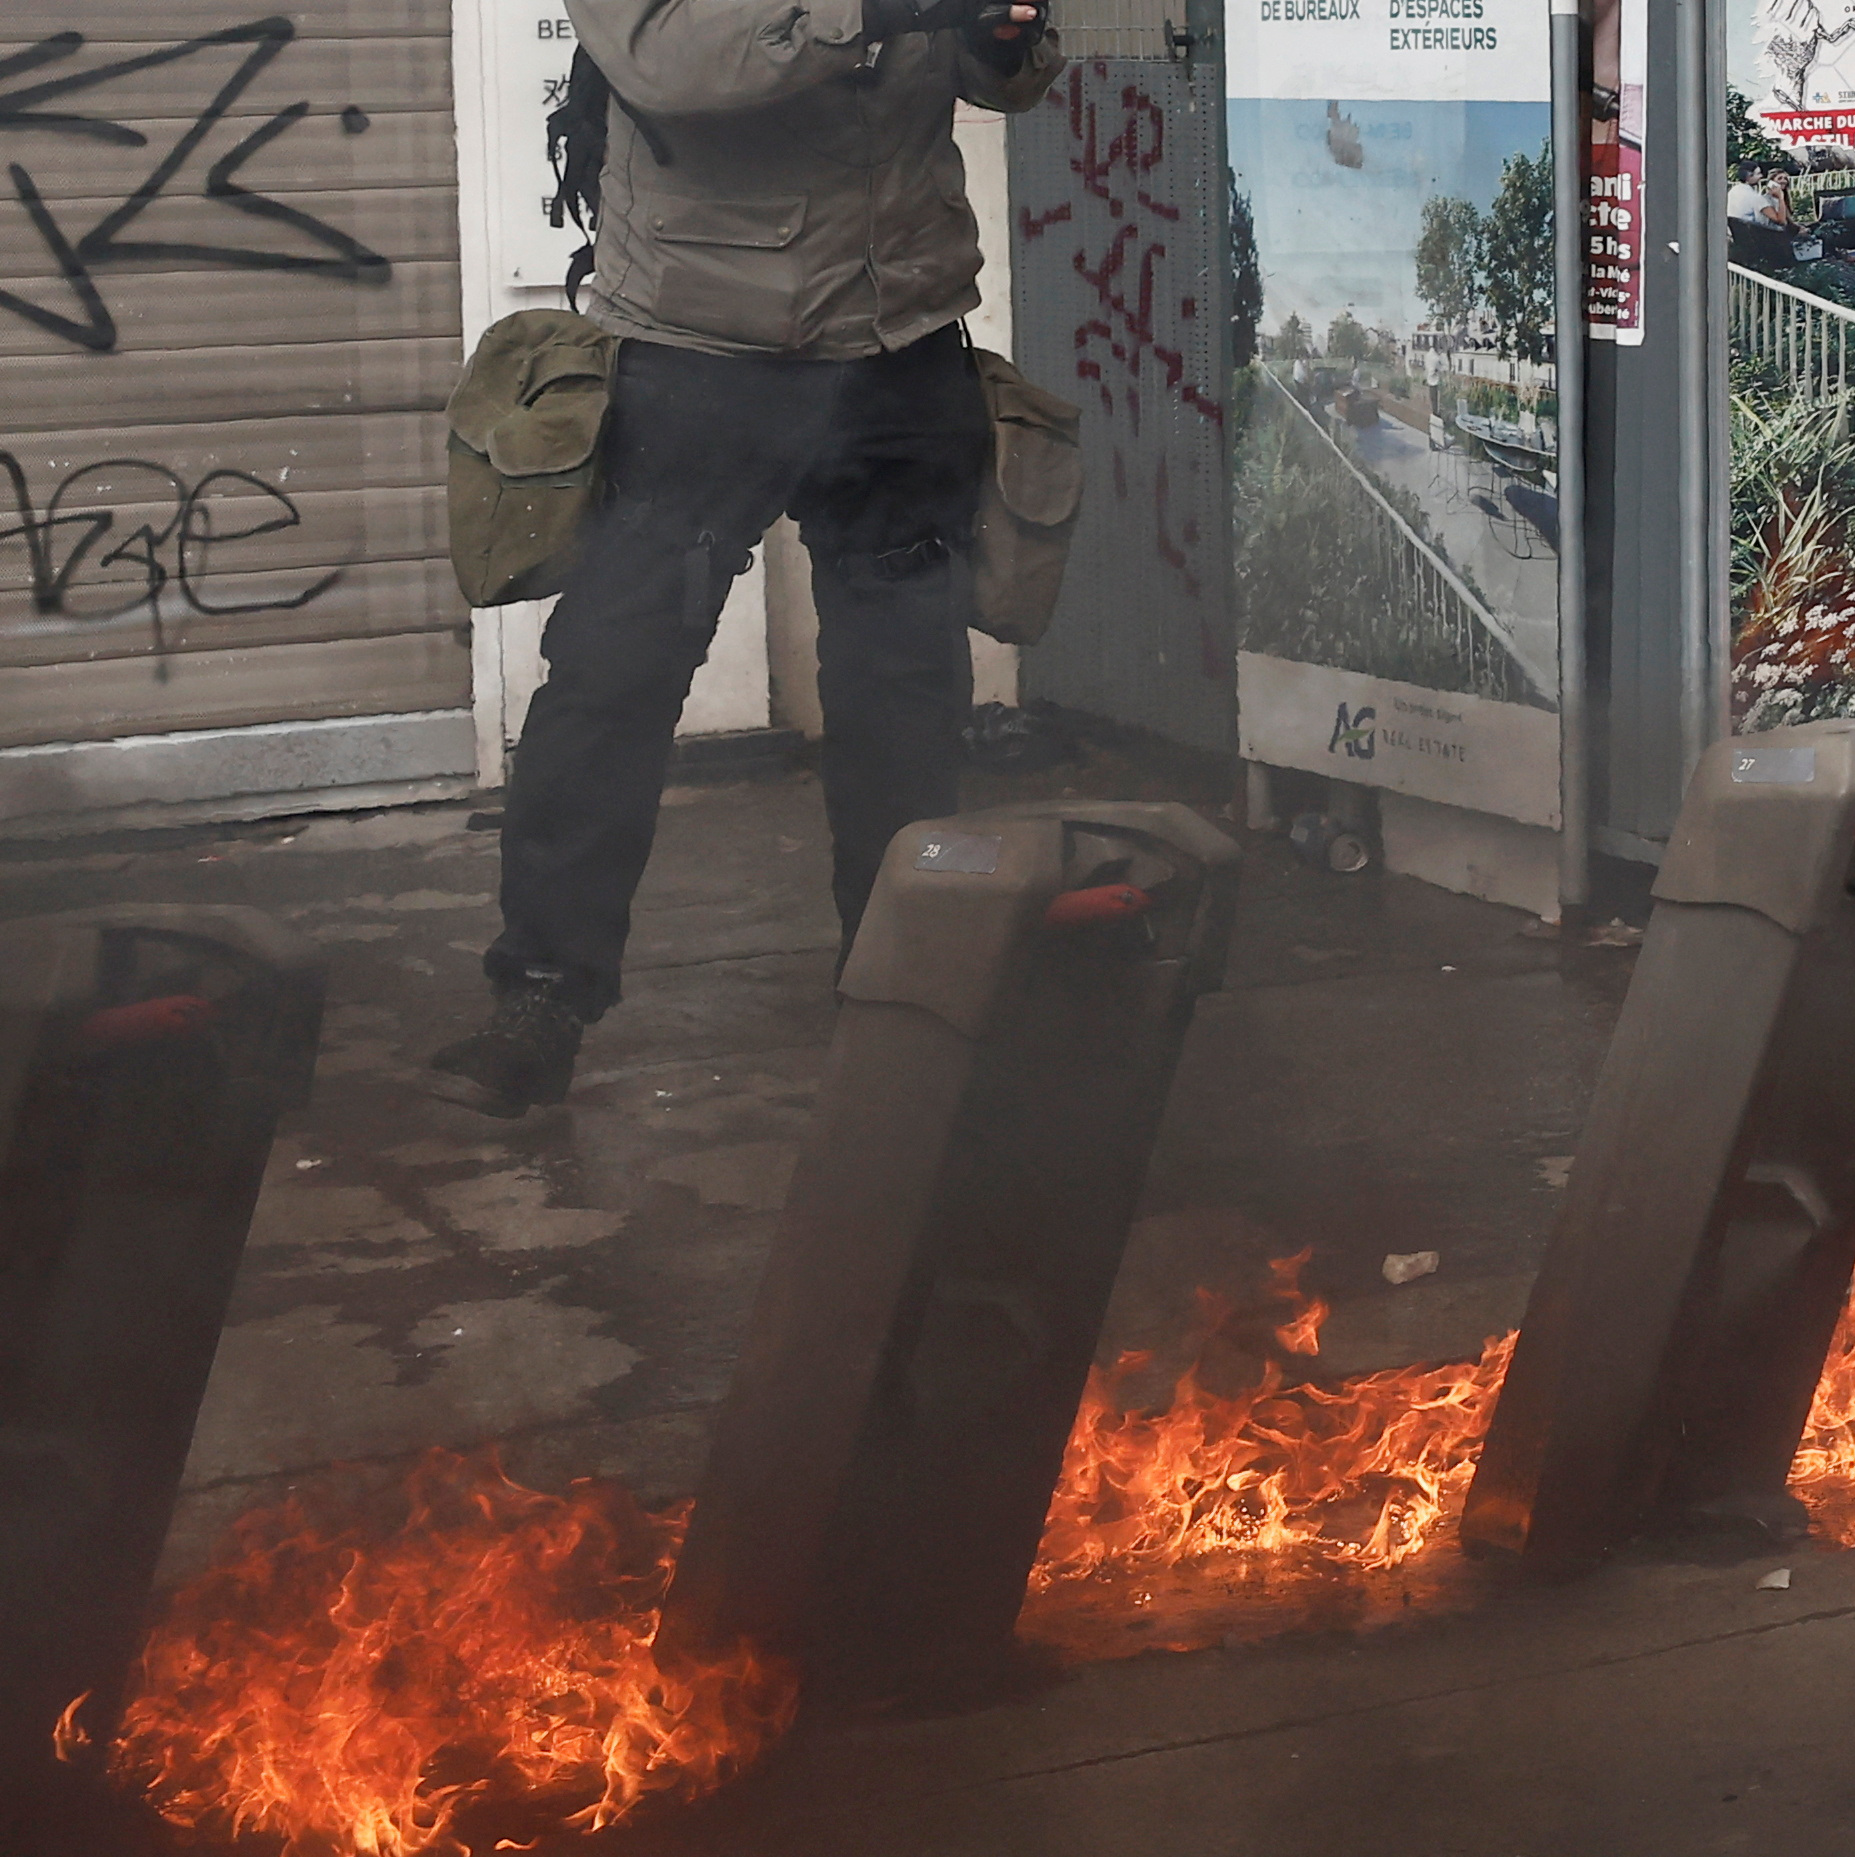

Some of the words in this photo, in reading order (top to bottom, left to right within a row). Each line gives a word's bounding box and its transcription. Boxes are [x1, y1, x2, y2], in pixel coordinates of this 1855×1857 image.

[1261, 0, 1281, 21] DE
[1390, 20, 1498, 51] EXTÉRIEURS
[1771, 116, 1833, 132] MARCHE
[1738, 758, 1755, 771] 27
[921, 843, 941, 858] 28
